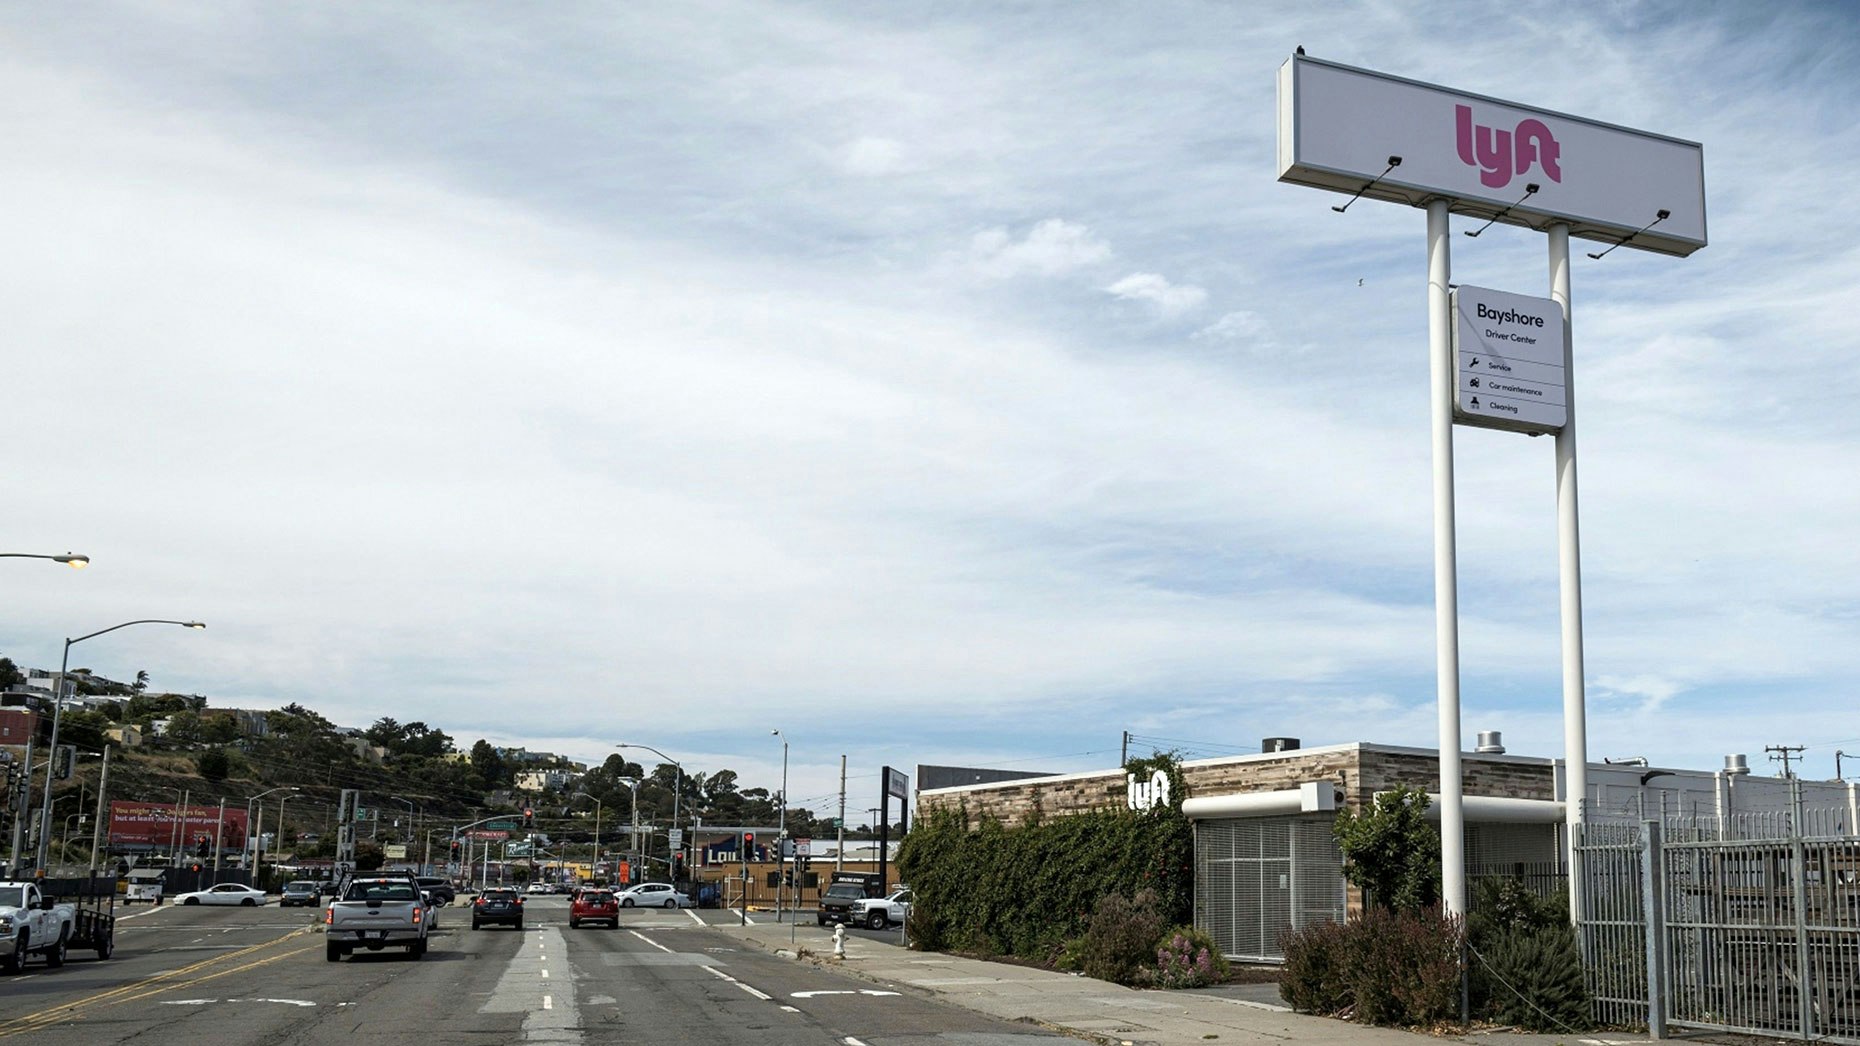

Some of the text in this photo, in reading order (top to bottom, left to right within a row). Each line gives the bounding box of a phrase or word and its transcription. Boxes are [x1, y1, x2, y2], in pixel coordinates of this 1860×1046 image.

[1455, 104, 1561, 188] lyft
[1477, 303, 1544, 328] Bayshore
[1485, 329, 1537, 345] Driver Center
[1488, 362, 1512, 372] Service
[1489, 381, 1543, 396] Car maintenance
[1489, 402, 1518, 414] Cleaning
